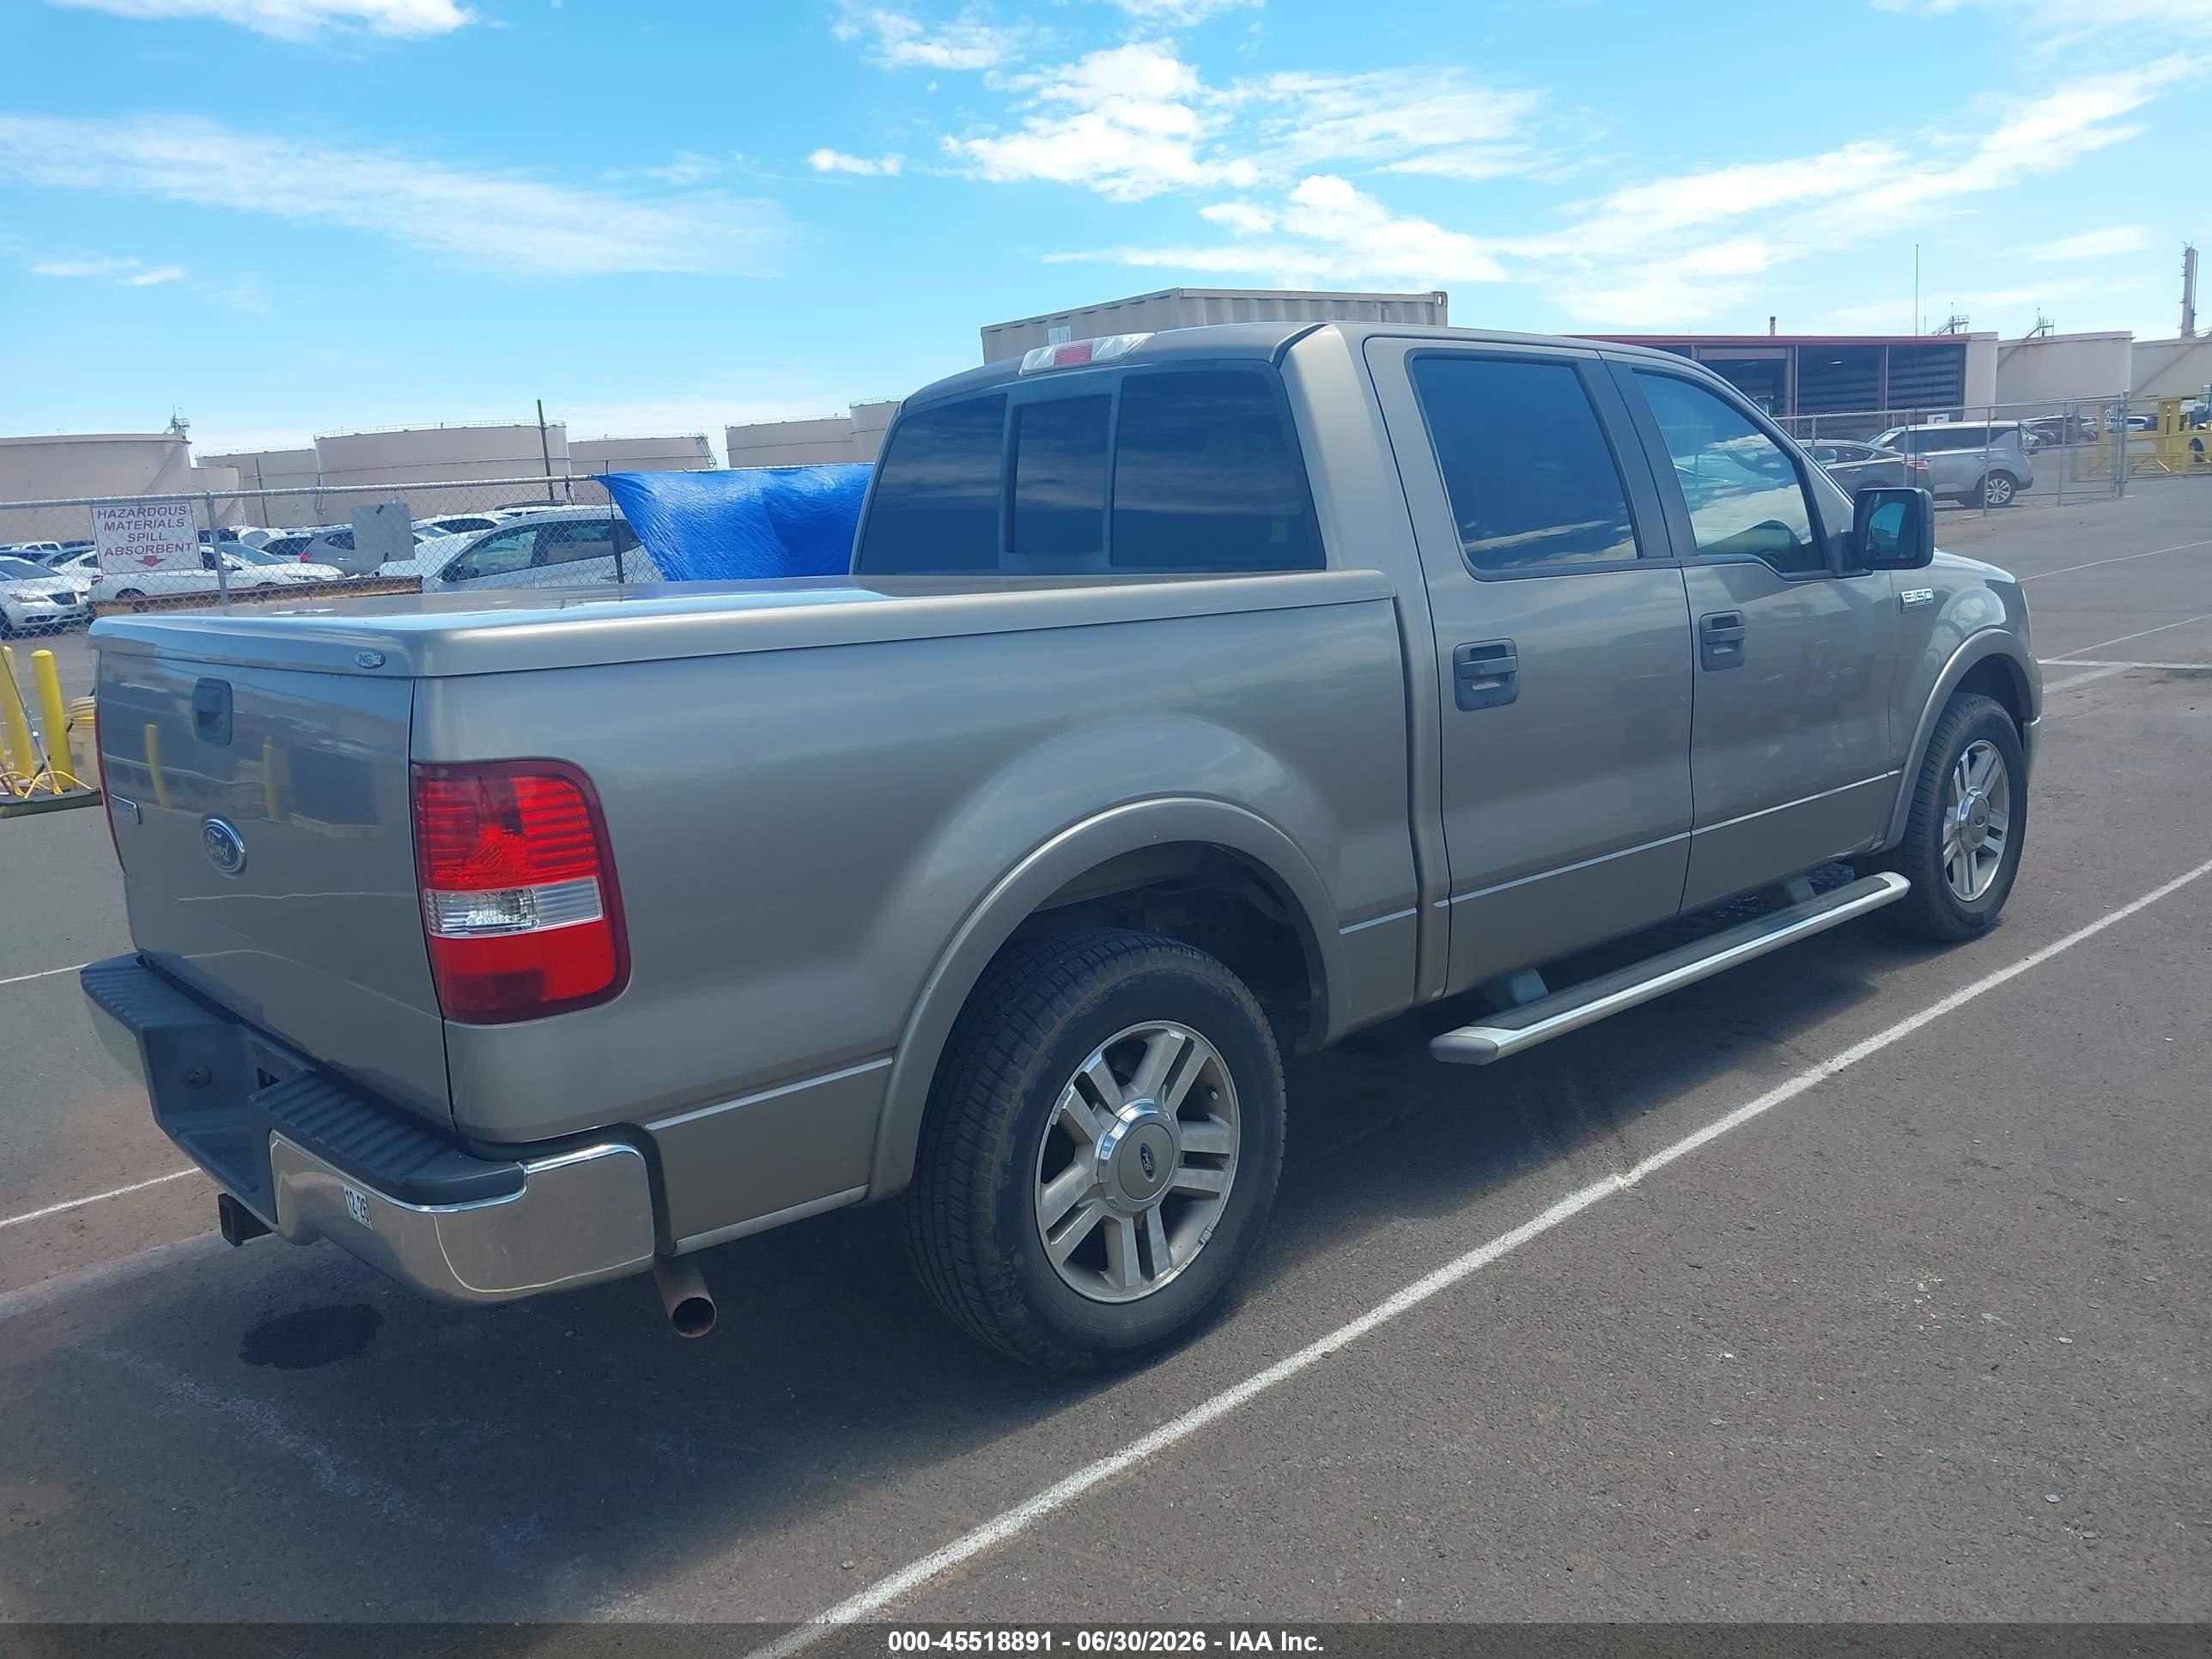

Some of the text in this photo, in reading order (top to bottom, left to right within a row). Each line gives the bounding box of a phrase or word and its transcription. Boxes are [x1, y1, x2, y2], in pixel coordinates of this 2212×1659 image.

[97, 506, 187, 520] HAZARDOUS
[104, 519, 185, 532] MATERIALS
[127, 532, 166, 543] SPILL
[104, 543, 193, 557] ABSORBENT
